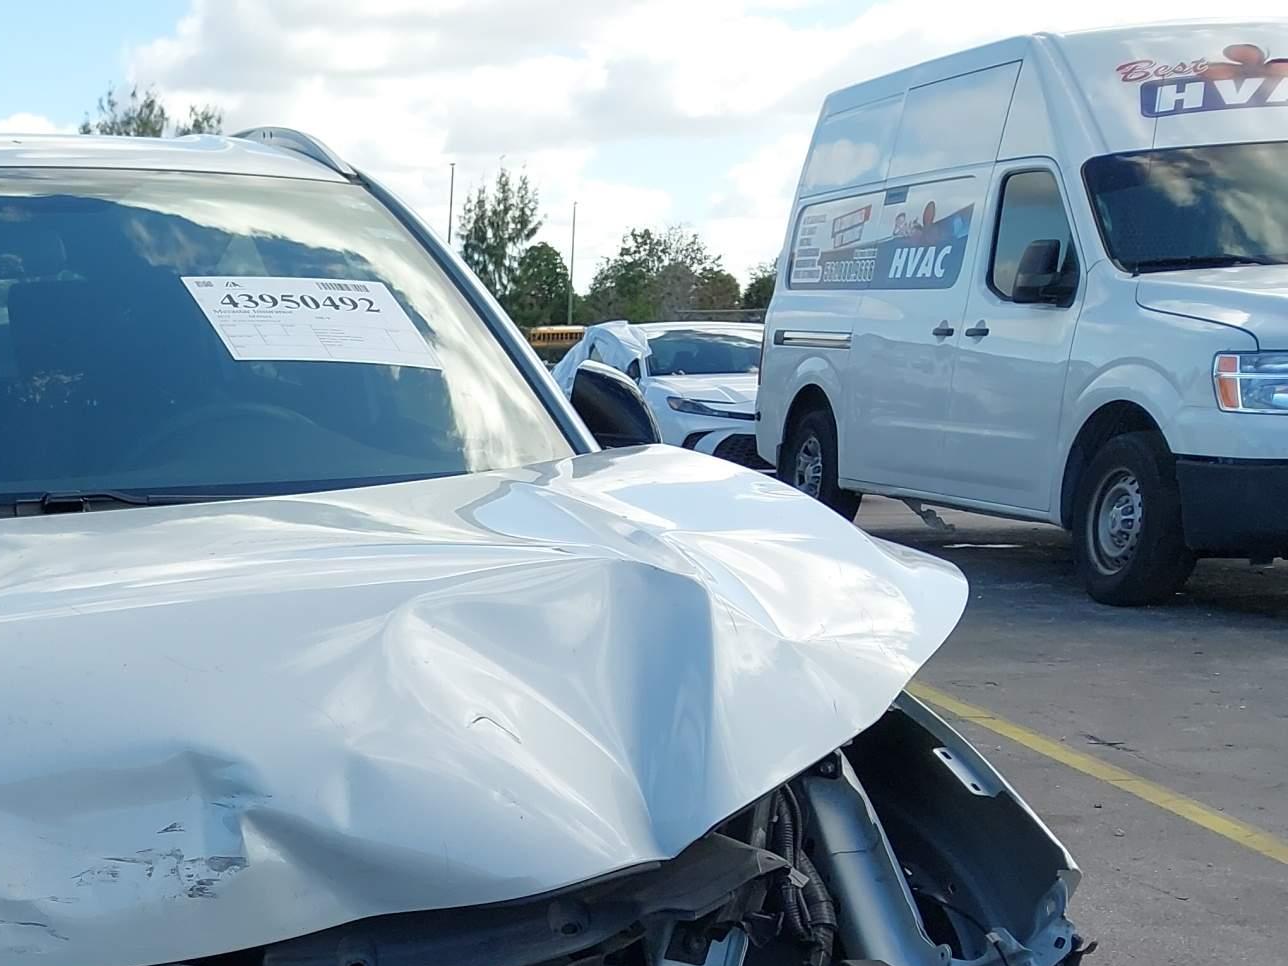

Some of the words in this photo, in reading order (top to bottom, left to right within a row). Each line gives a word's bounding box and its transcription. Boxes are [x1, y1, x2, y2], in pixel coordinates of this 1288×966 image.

[1115, 57, 1210, 83] Best
[888, 245, 953, 279] HVAC
[220, 293, 381, 313] 43950492
